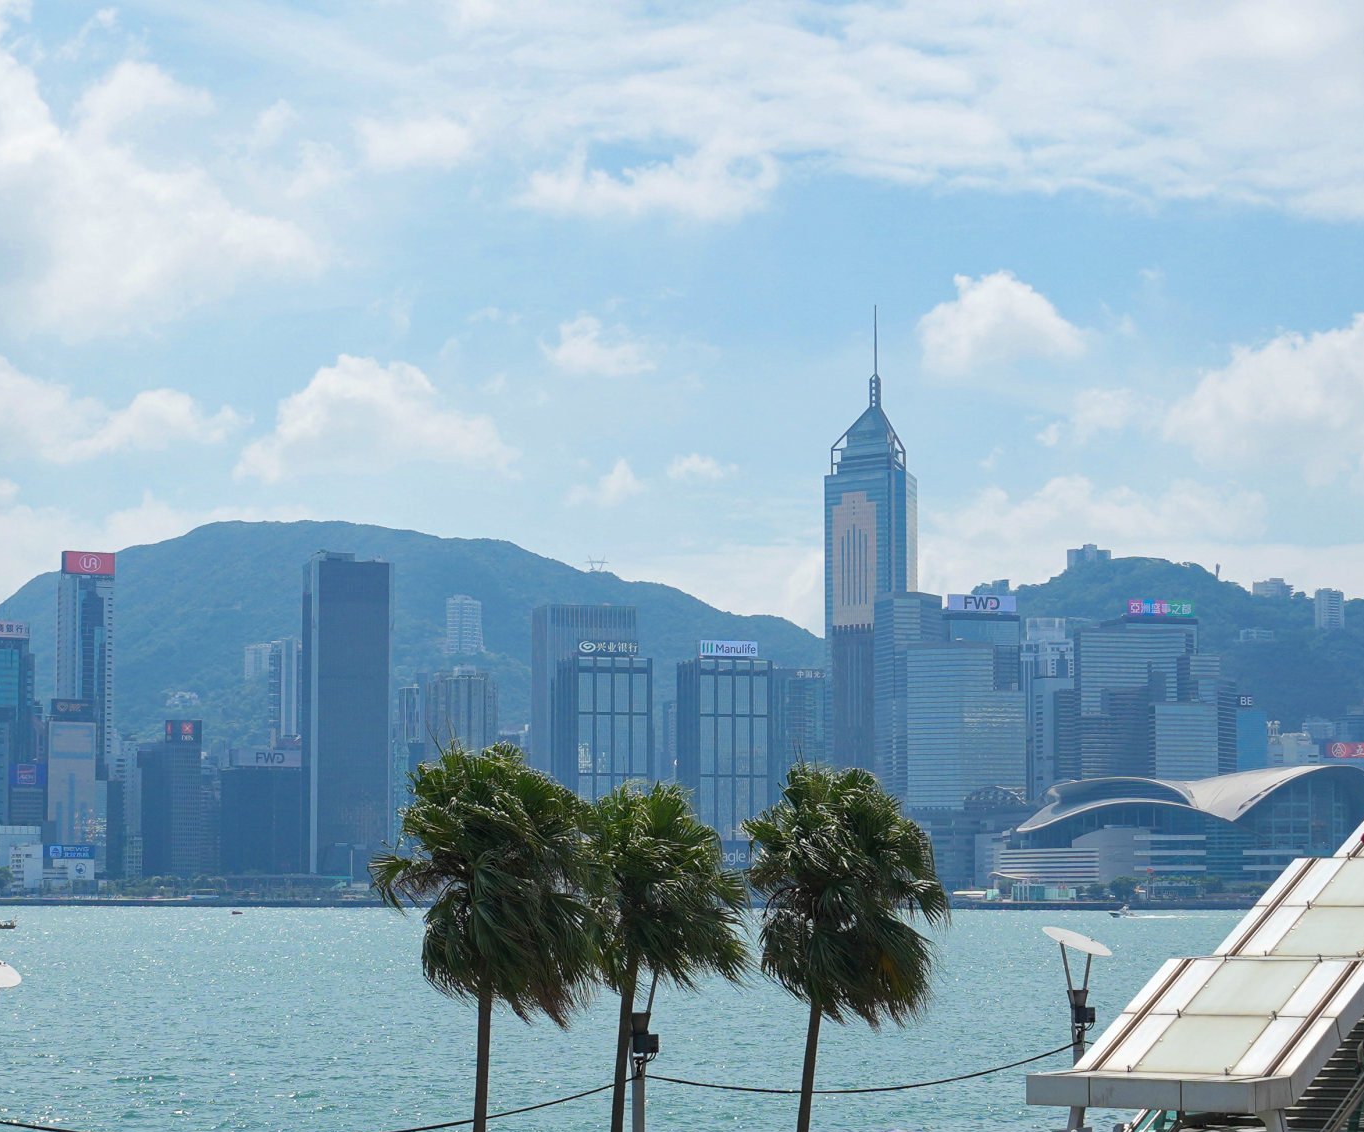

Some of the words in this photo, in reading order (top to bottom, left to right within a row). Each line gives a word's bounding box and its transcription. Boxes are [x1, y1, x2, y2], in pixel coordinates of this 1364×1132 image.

[964, 596, 1000, 611] FWD
[715, 643, 757, 655] Manulife
[255, 752, 285, 764] FWD
